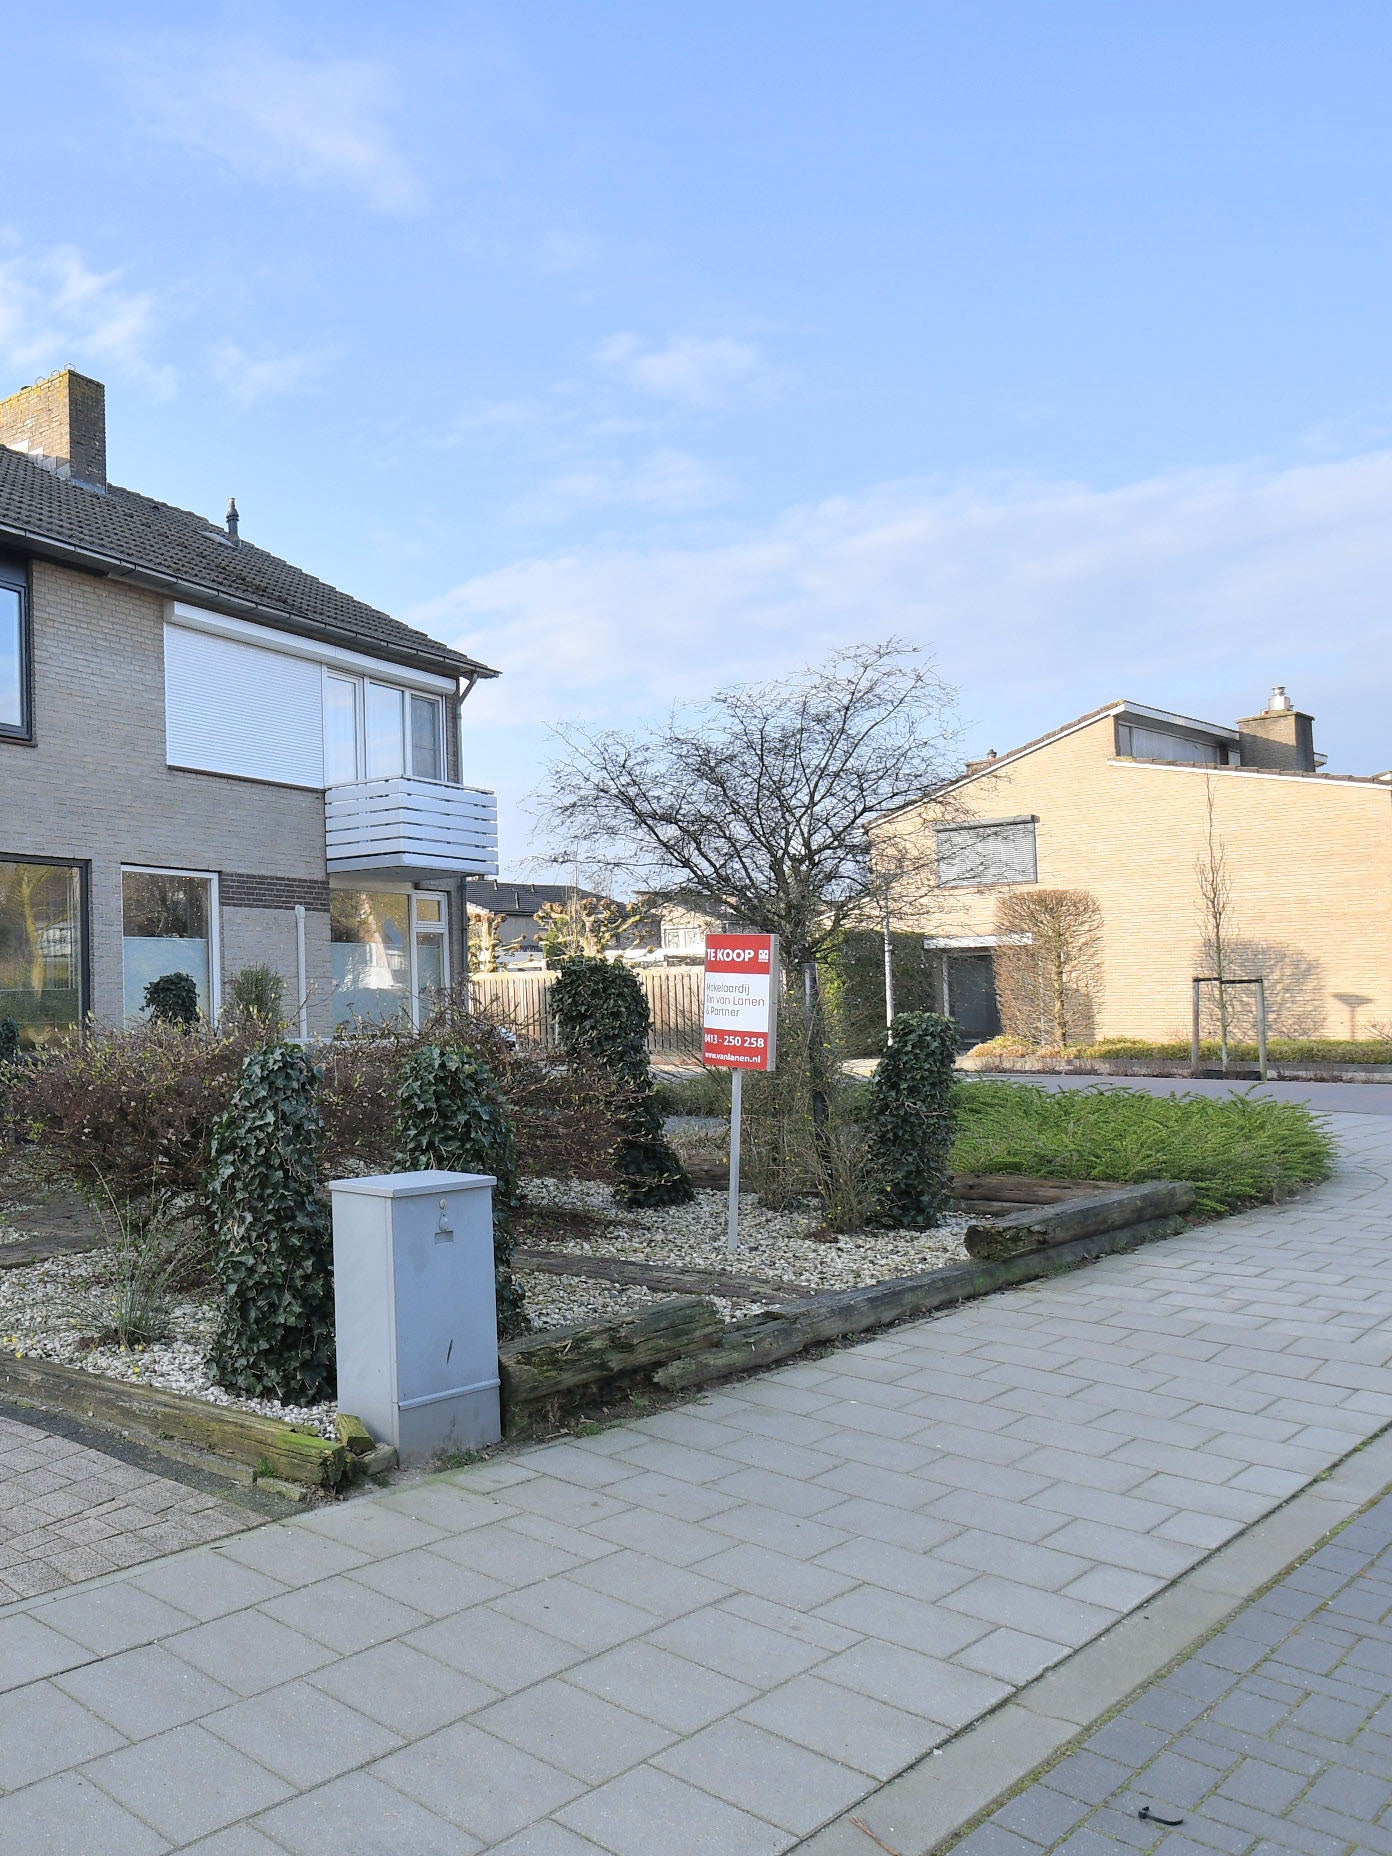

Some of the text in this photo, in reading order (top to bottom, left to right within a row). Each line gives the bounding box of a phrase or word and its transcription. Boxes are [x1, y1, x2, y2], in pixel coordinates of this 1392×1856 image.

[706, 948, 755, 962] TE KOOP
[716, 996, 731, 1005] van
[733, 996, 765, 1007] Lanen
[710, 1006, 740, 1017] Partner
[723, 1035, 742, 1047] 250
[743, 1036, 765, 1048] 258
